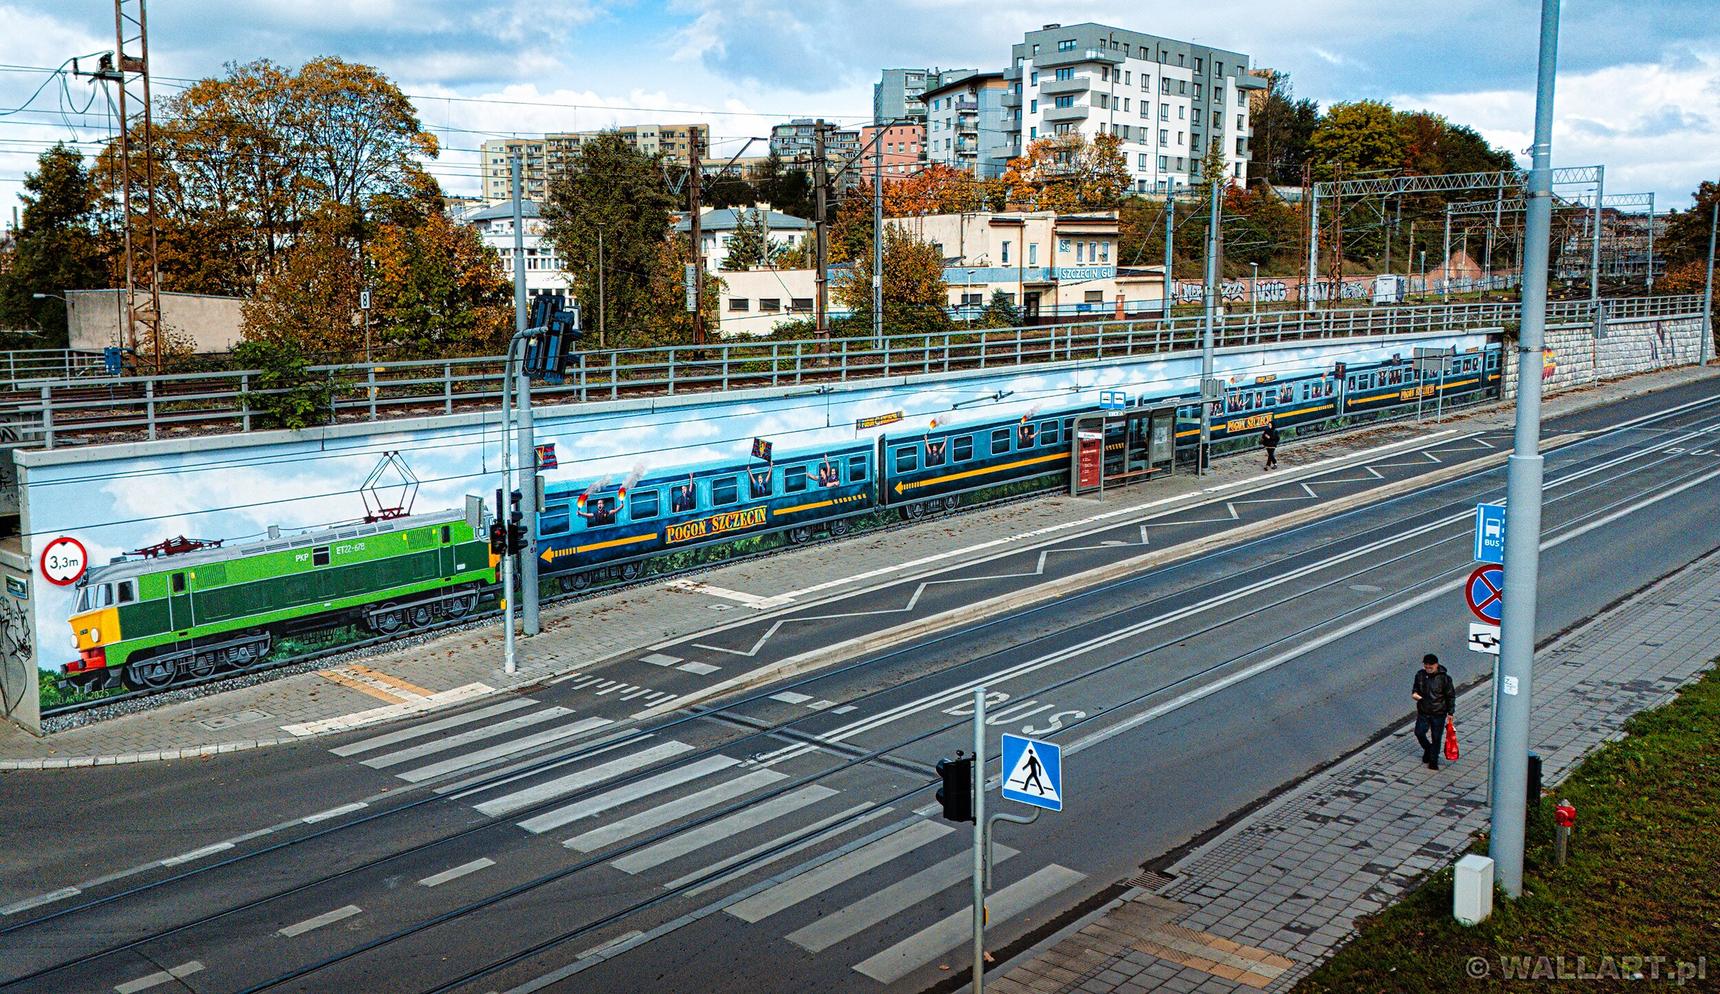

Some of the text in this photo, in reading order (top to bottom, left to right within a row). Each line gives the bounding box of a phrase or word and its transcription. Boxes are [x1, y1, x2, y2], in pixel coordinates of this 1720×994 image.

[1062, 268, 1098, 279] SZCZECIN
[362, 293, 368, 307] 8
[1662, 447, 1720, 457] BU
[712, 507, 766, 531] SZCZECIN
[1484, 538, 1500, 547] BUS
[295, 553, 309, 563] PKP
[941, 691, 1087, 735] BUS
